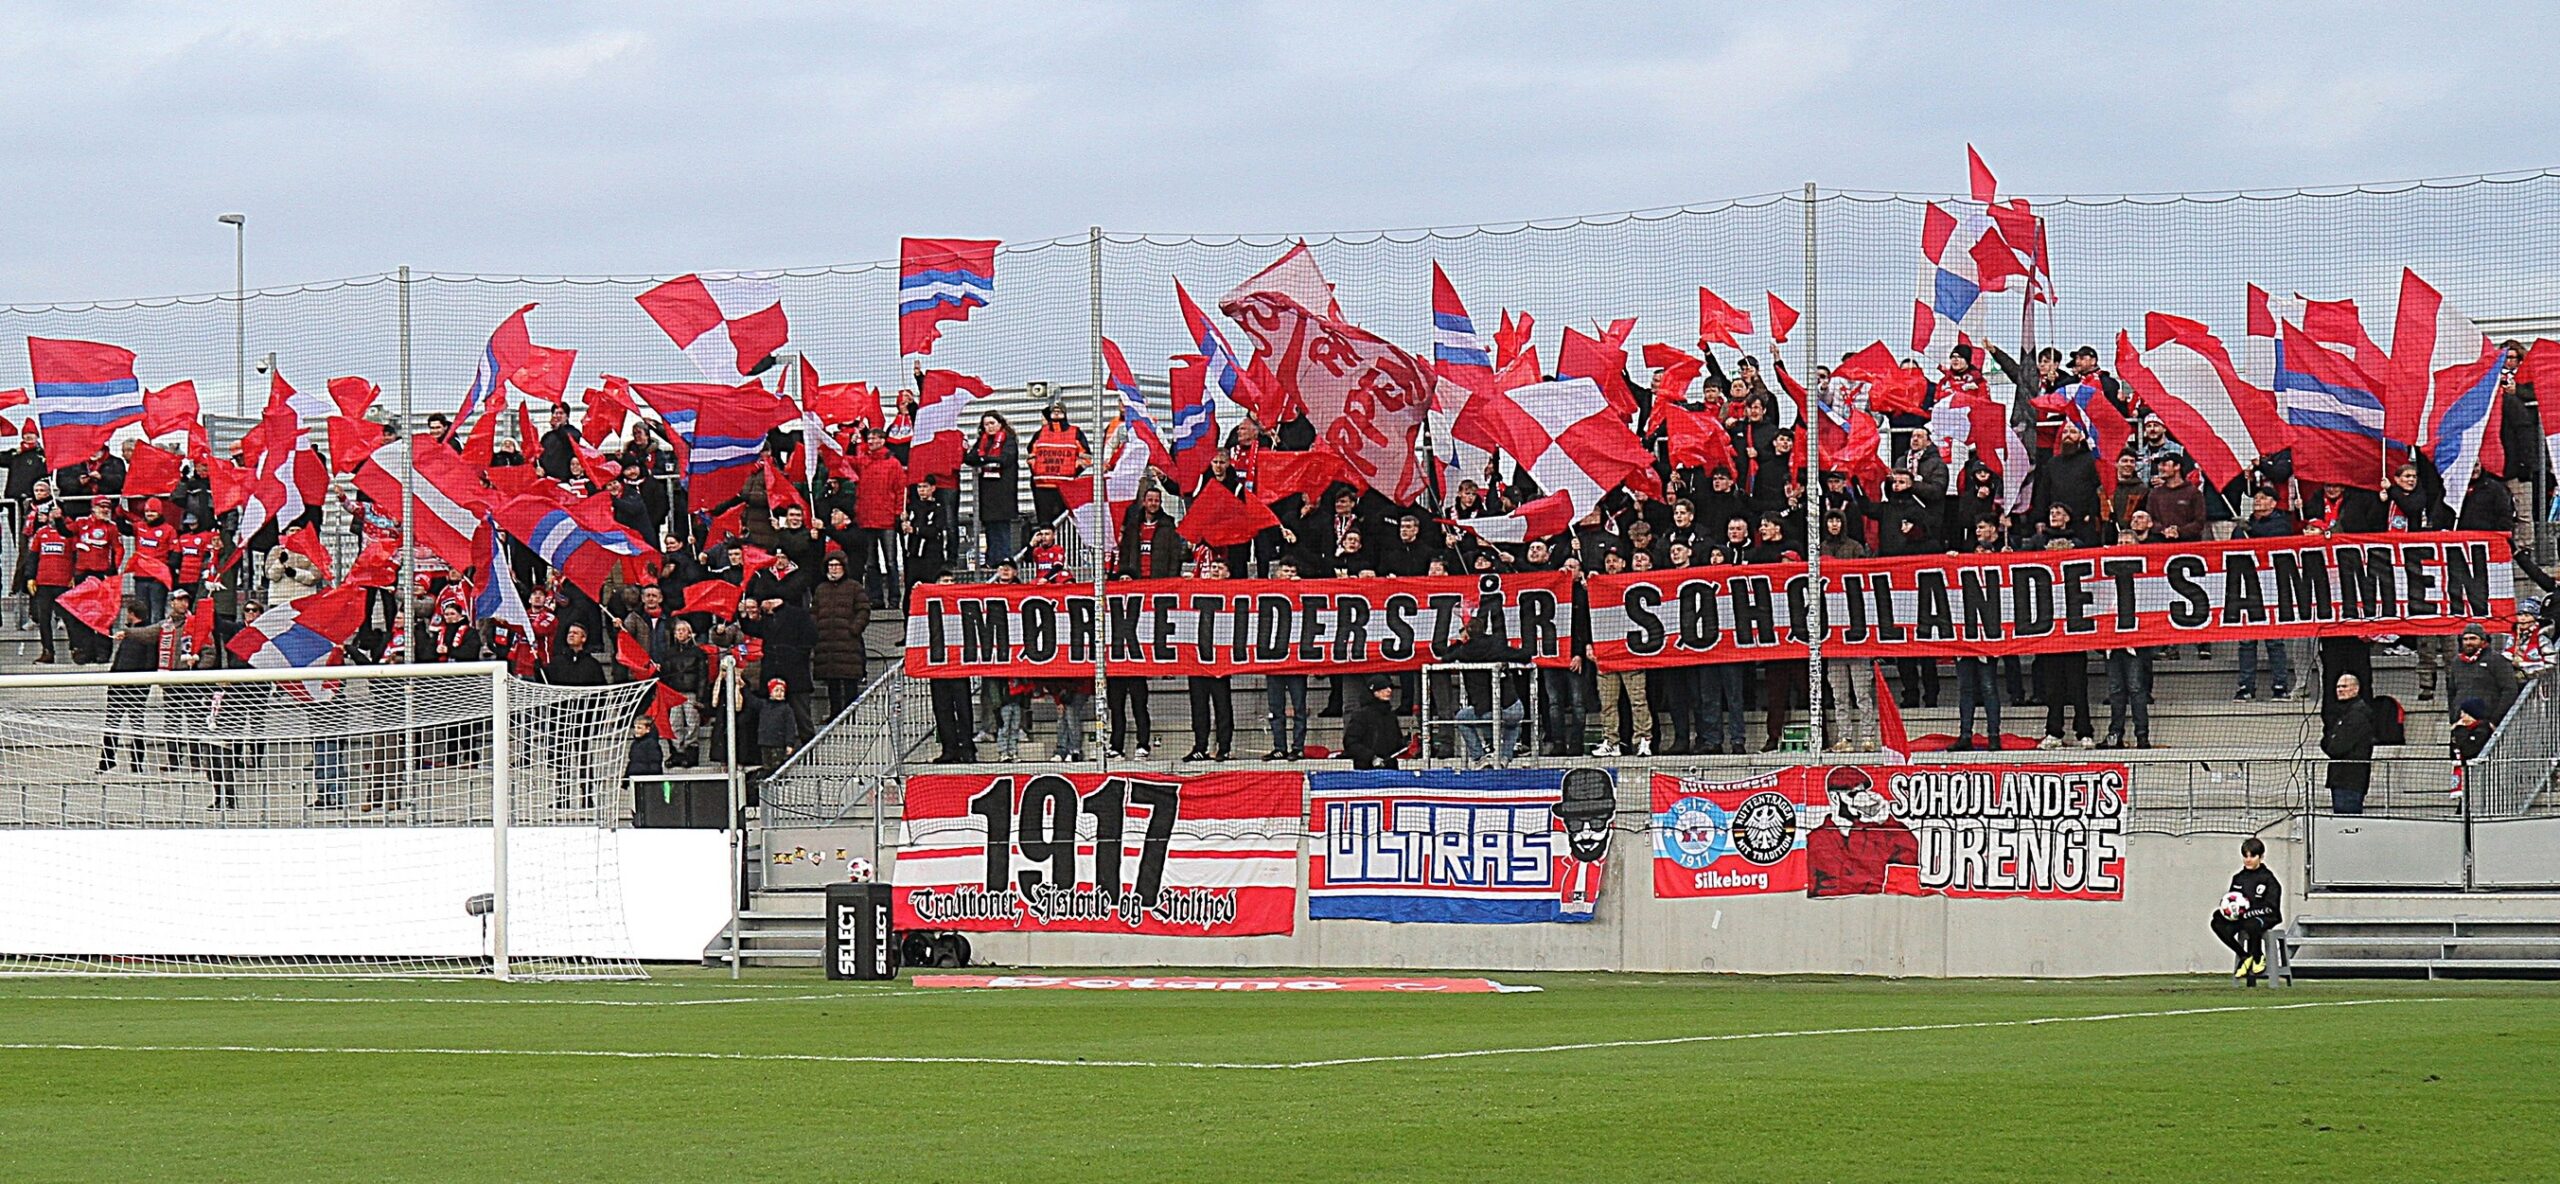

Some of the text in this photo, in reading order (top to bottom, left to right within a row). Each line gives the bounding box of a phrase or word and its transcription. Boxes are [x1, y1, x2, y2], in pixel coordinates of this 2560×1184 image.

[928, 573, 1559, 666] I MØRKE TIDER STÅR
[1624, 541, 2492, 652] SØHØJLANDET SAMMEN
[1889, 769, 2121, 819] SØHØJLANDETS
[970, 774, 1183, 912] 1917
[1325, 803, 1554, 888] ULTRAS
[1680, 852, 1711, 867] 1917
[1694, 868, 1769, 889] Silkeborg
[1737, 834, 1792, 861] MIT TRADITION
[1919, 817, 2120, 893] DRENGE
[838, 904, 855, 975] SELECT
[876, 904, 887, 975] SELECT
[910, 883, 1236, 930] Traditioner, Historie og Stolthed
